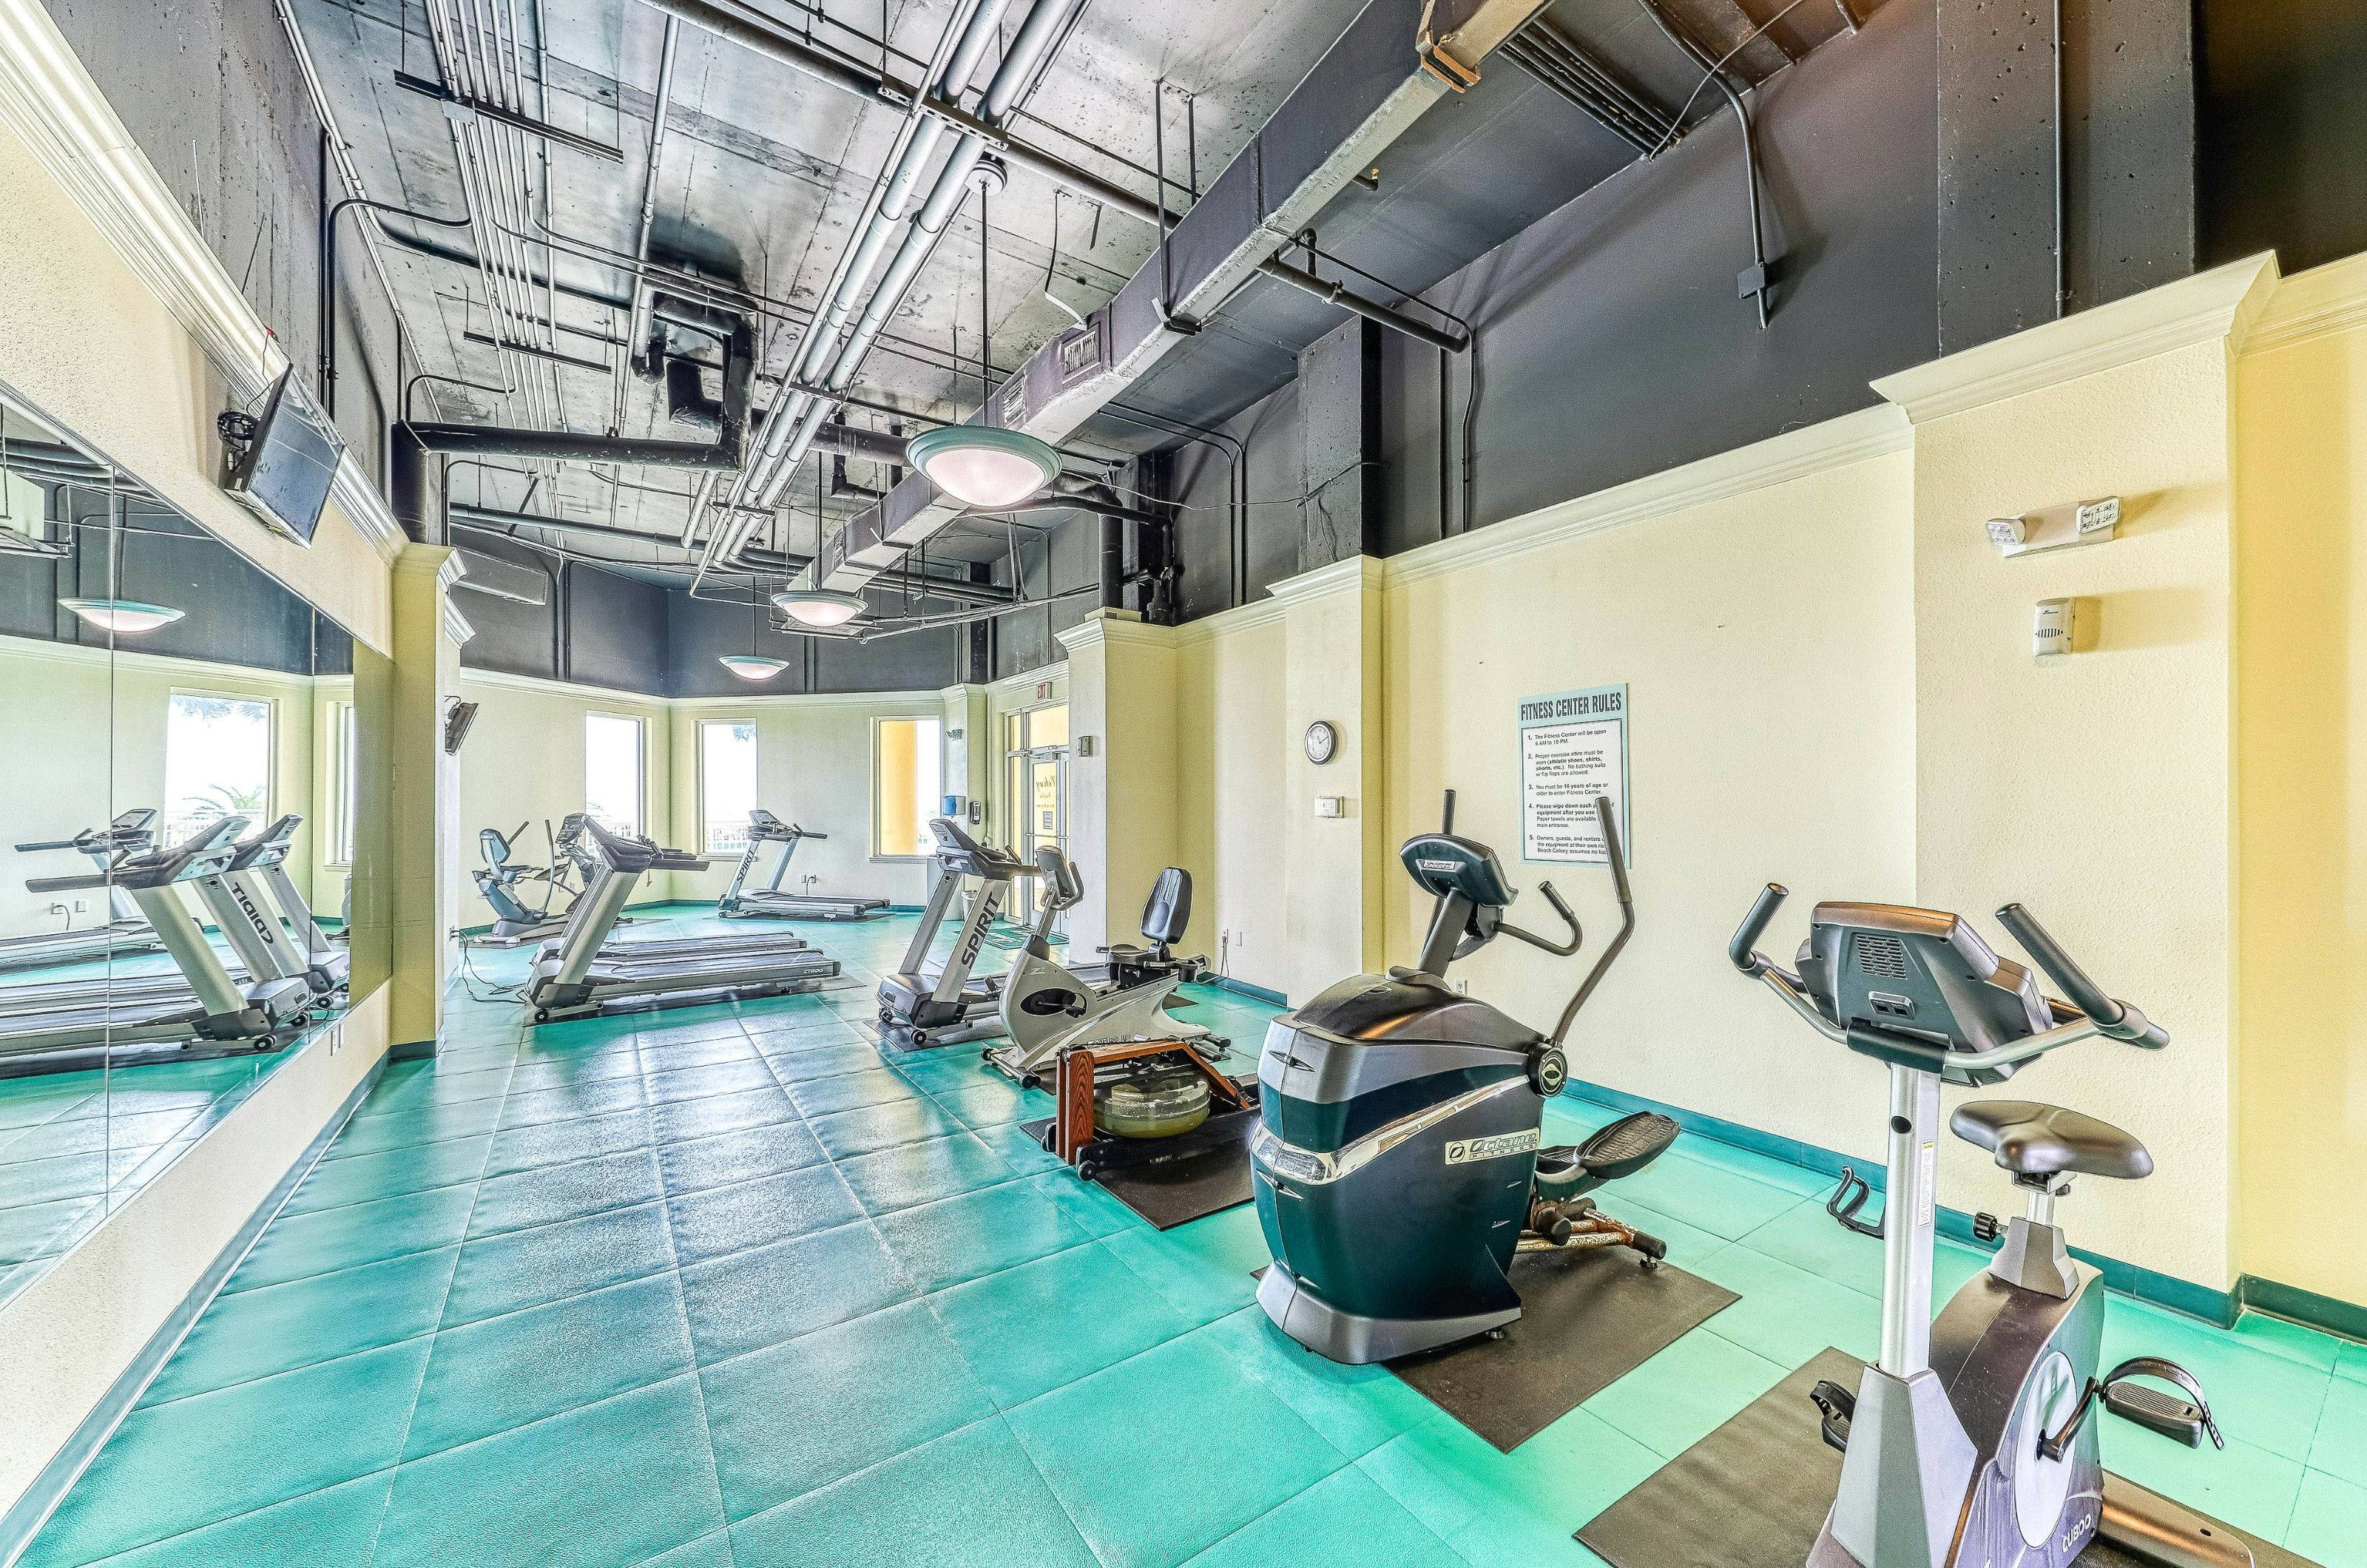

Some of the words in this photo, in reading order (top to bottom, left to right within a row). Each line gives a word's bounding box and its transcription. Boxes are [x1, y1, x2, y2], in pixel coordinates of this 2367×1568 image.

[1037, 684, 1046, 699] EXIT
[1521, 701, 1553, 720] FITNESS
[1556, 697, 1590, 717] CENTER
[1593, 692, 1621, 712] RULES
[737, 846, 754, 885] SPIRIT
[962, 891, 999, 970] SPIRIT
[1470, 1133, 1536, 1152] Octane
[1472, 1144, 1534, 1159] FITNESS
